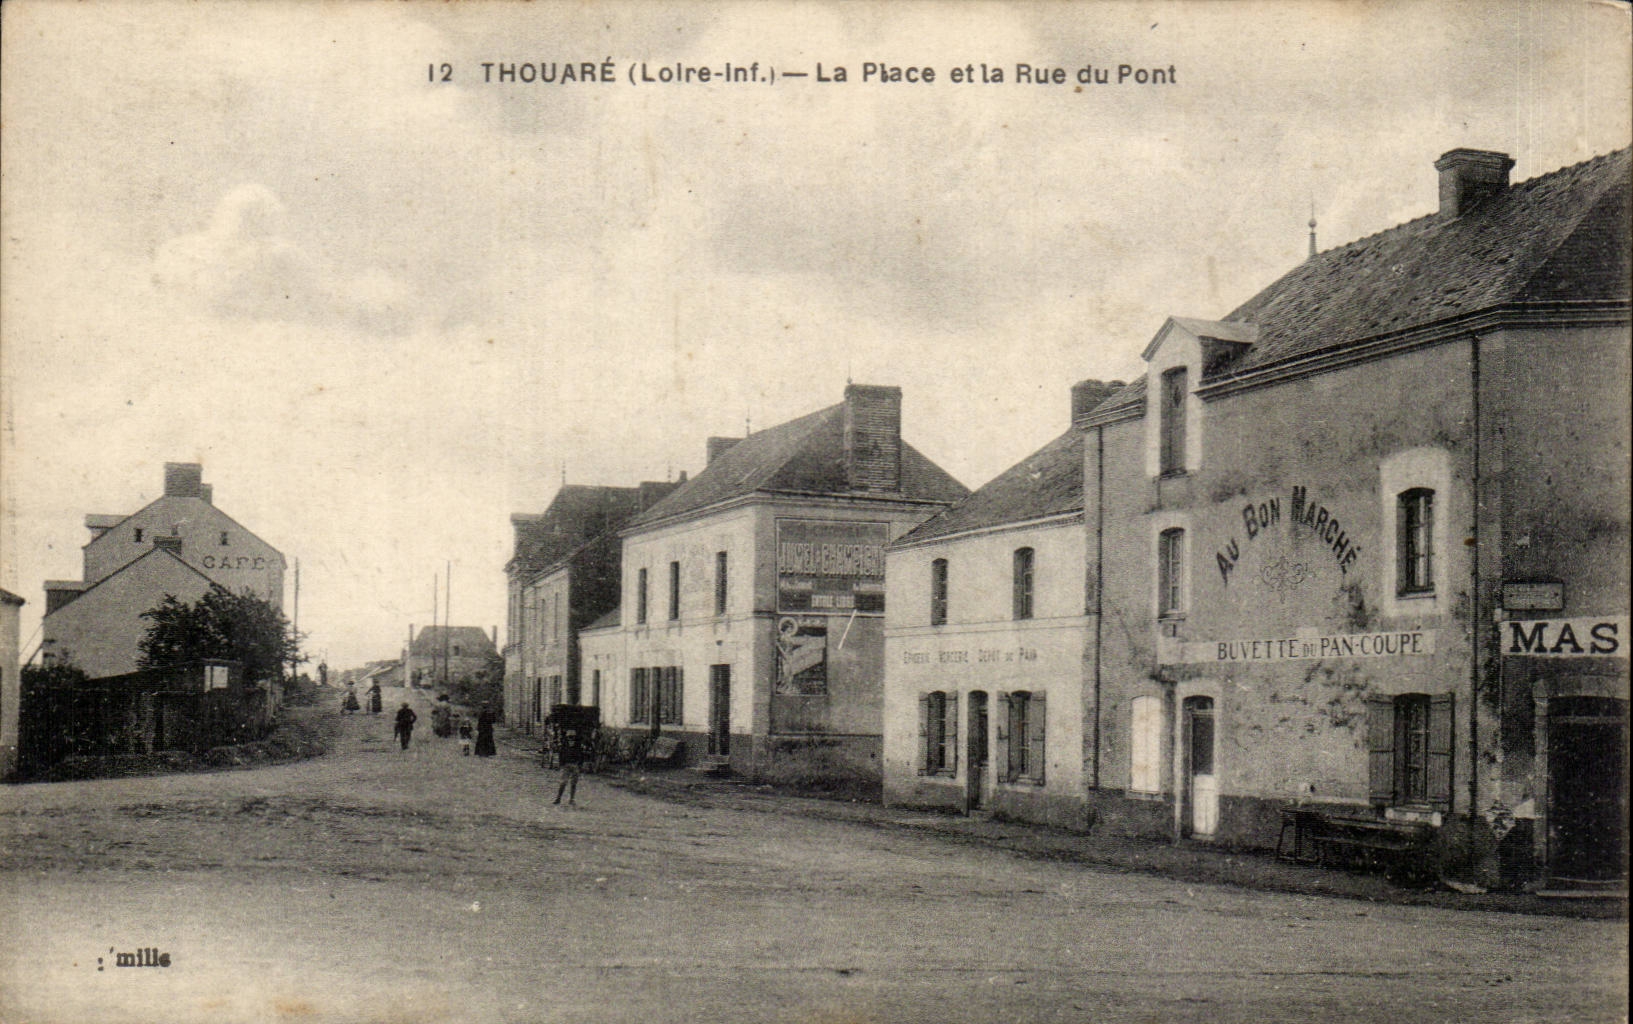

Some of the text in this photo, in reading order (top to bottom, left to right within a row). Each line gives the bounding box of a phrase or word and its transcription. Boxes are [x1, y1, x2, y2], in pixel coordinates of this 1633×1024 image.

[1216, 538, 1240, 585] AU
[1242, 497, 1281, 540] BON
[1217, 638, 1299, 661] BUVETTE
